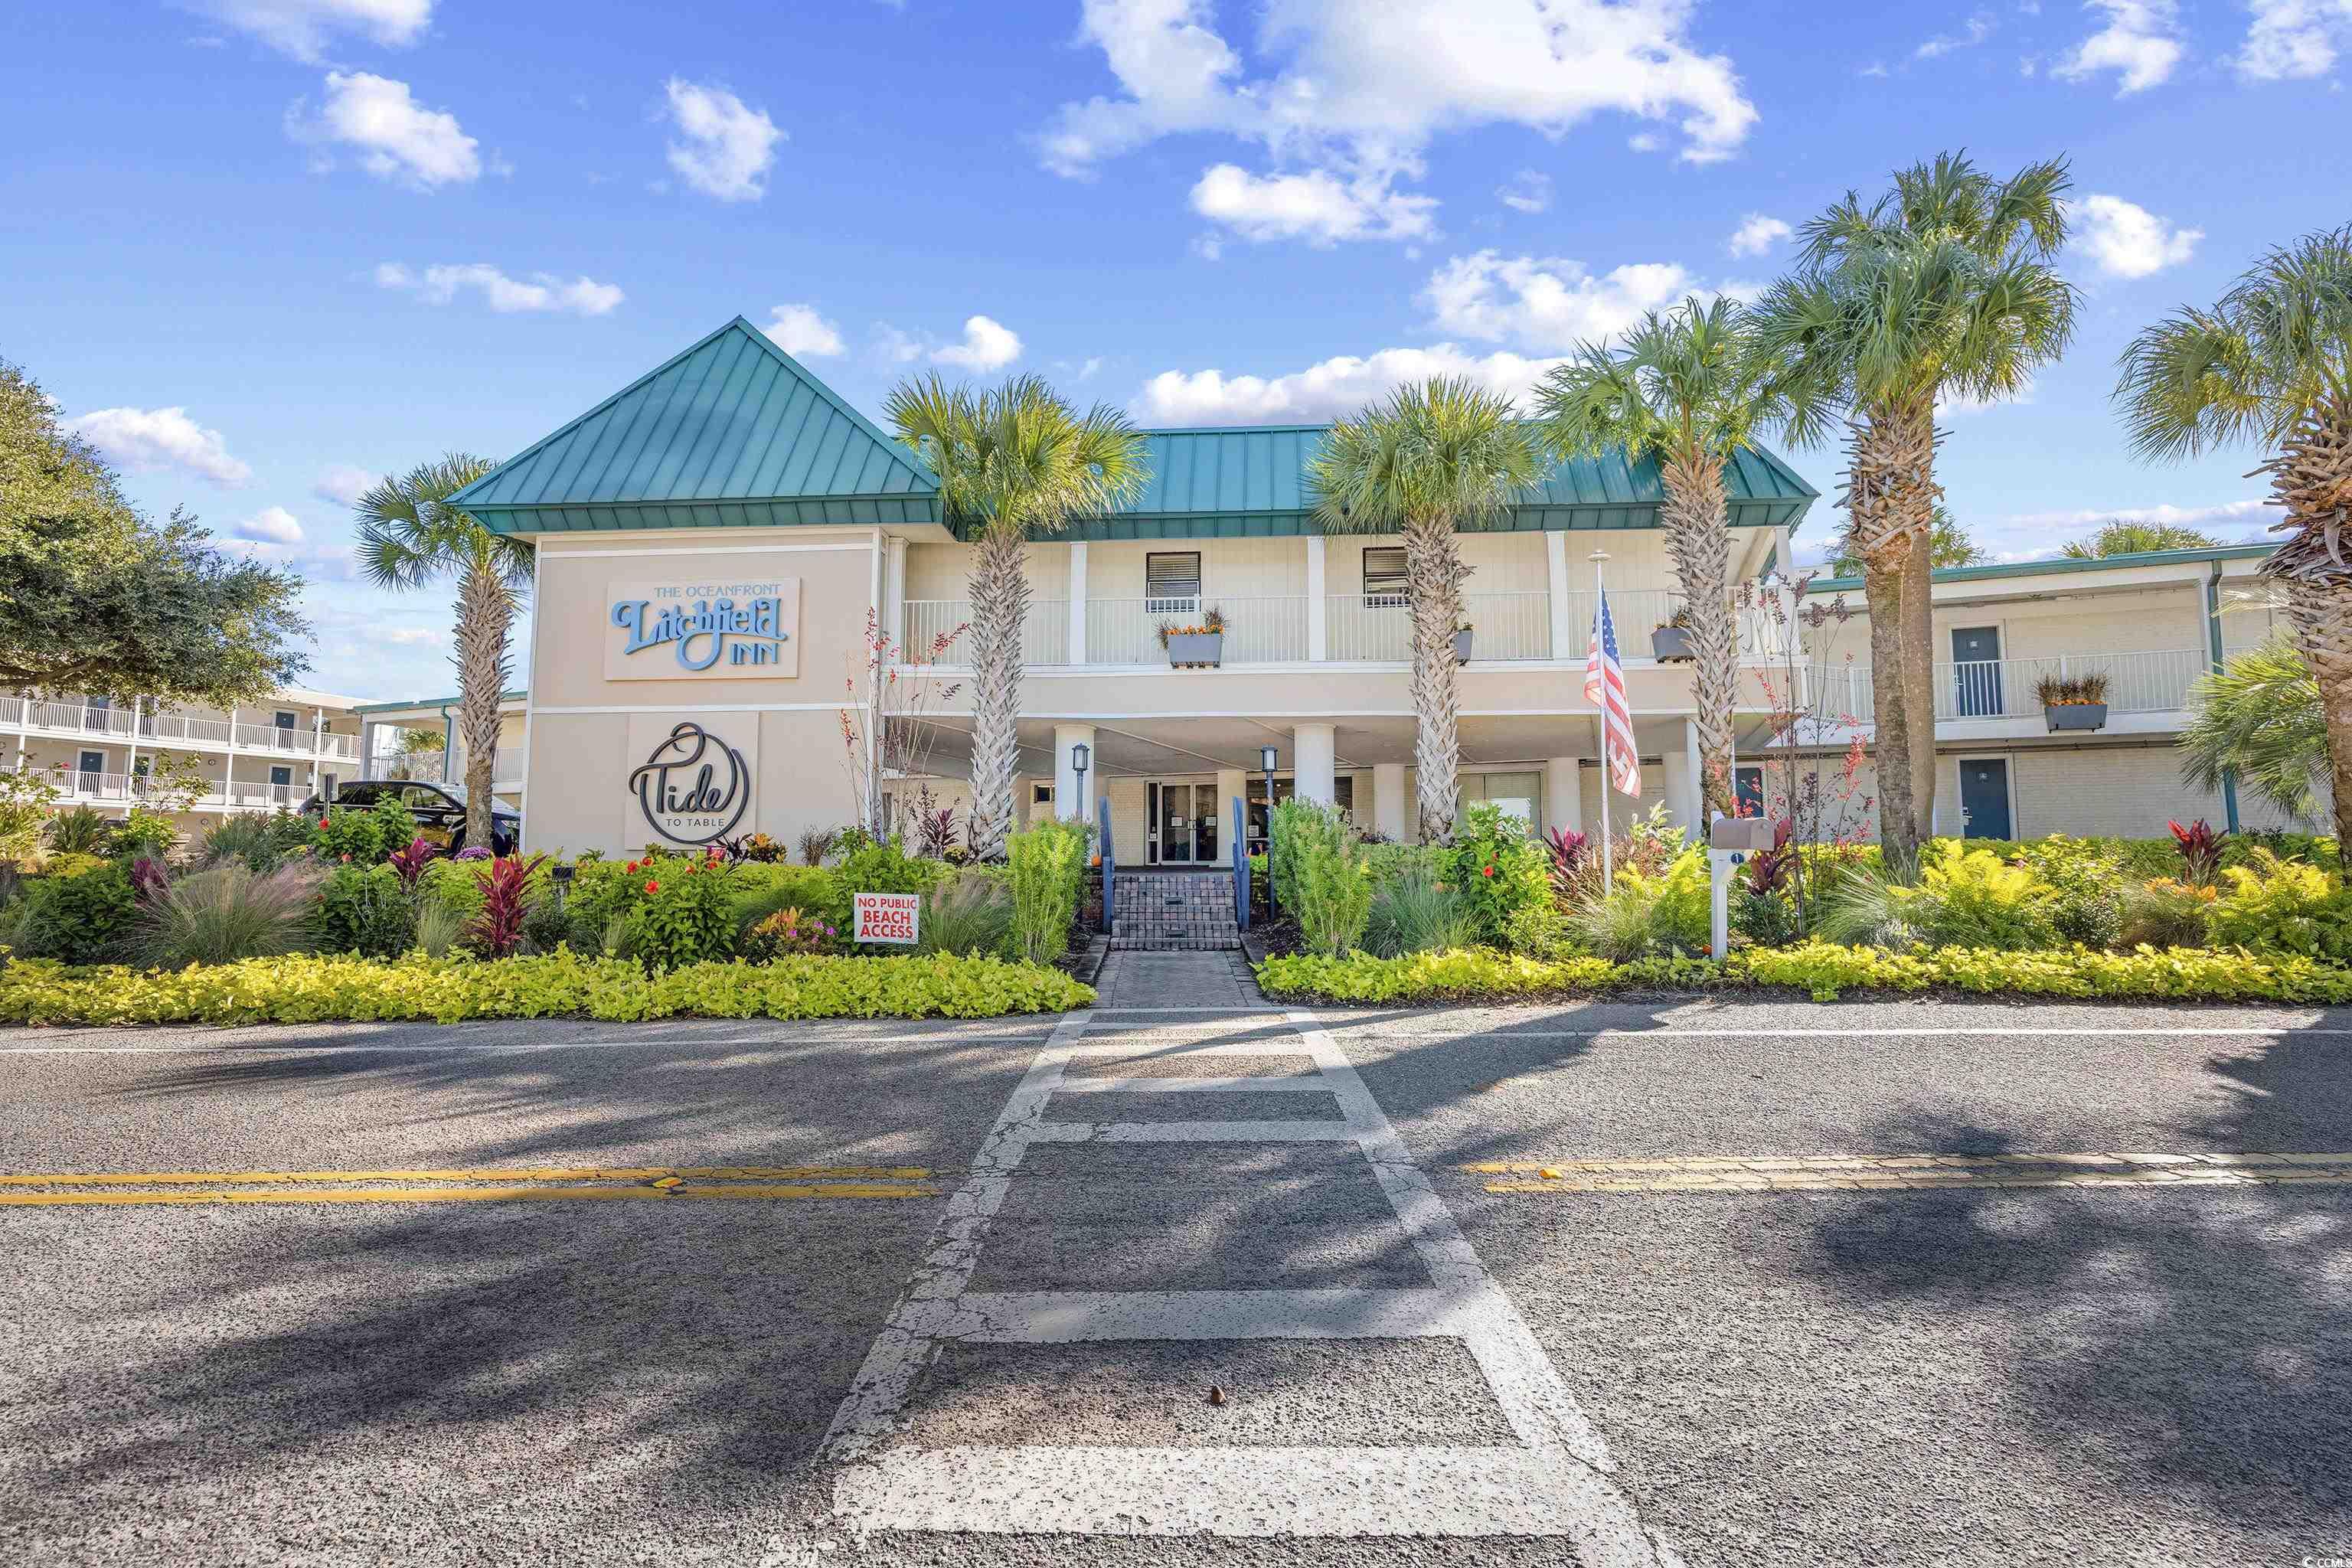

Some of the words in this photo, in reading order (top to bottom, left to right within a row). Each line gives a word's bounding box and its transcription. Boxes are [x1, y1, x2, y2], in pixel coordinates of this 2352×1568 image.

[654, 587, 681, 598] THE
[685, 583, 781, 597] OCEANFRONT
[612, 597, 788, 670] Litchfield
[728, 642, 779, 665] INN
[629, 722, 722, 814] Tide
[666, 818, 681, 827] TO
[688, 818, 725, 827] TABLE
[858, 898, 876, 907] NO
[880, 898, 916, 910] PUBLIC
[863, 910, 910, 924] BEACH
[860, 924, 913, 939] ACCESS
